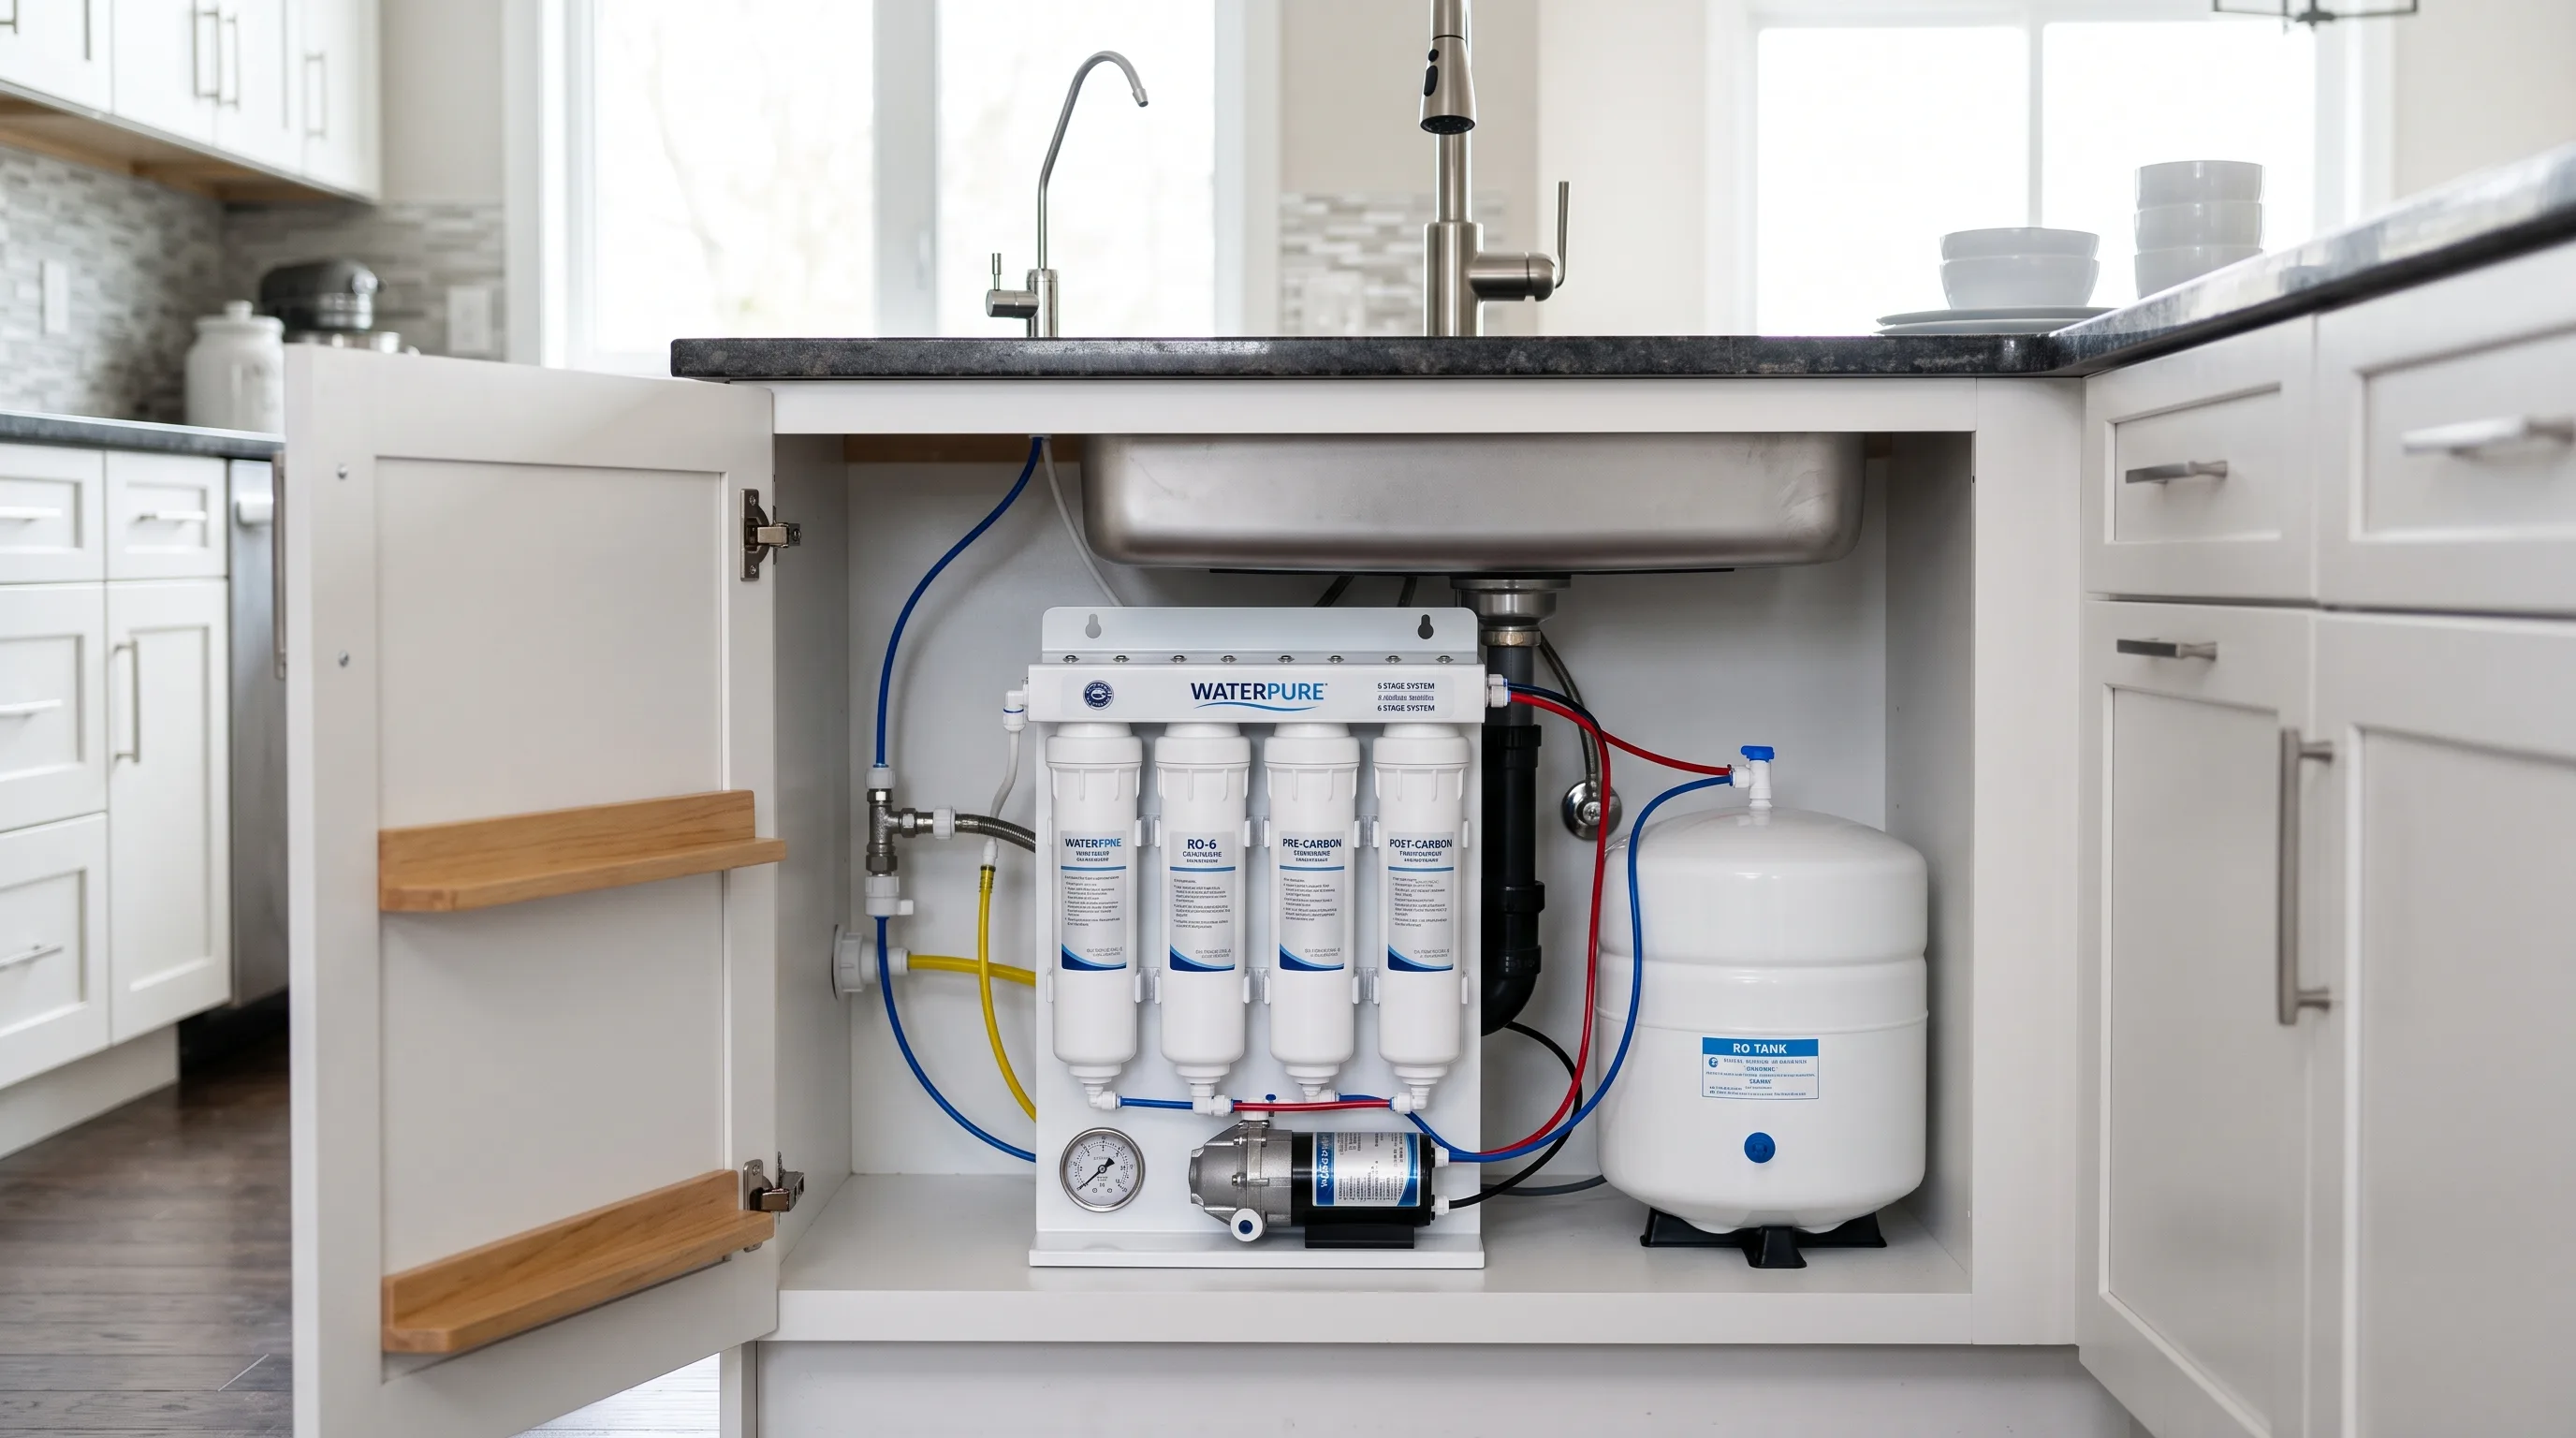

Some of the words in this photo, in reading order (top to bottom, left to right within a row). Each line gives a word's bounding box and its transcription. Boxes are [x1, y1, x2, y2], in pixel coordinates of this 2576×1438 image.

[1190, 682, 1325, 701] WATERPURE
[1187, 839, 1217, 850] RO-6
[1282, 838, 1342, 848] PRE-CARBON
[1733, 1043, 1750, 1053] RO
[1753, 1044, 1787, 1054] TANK
